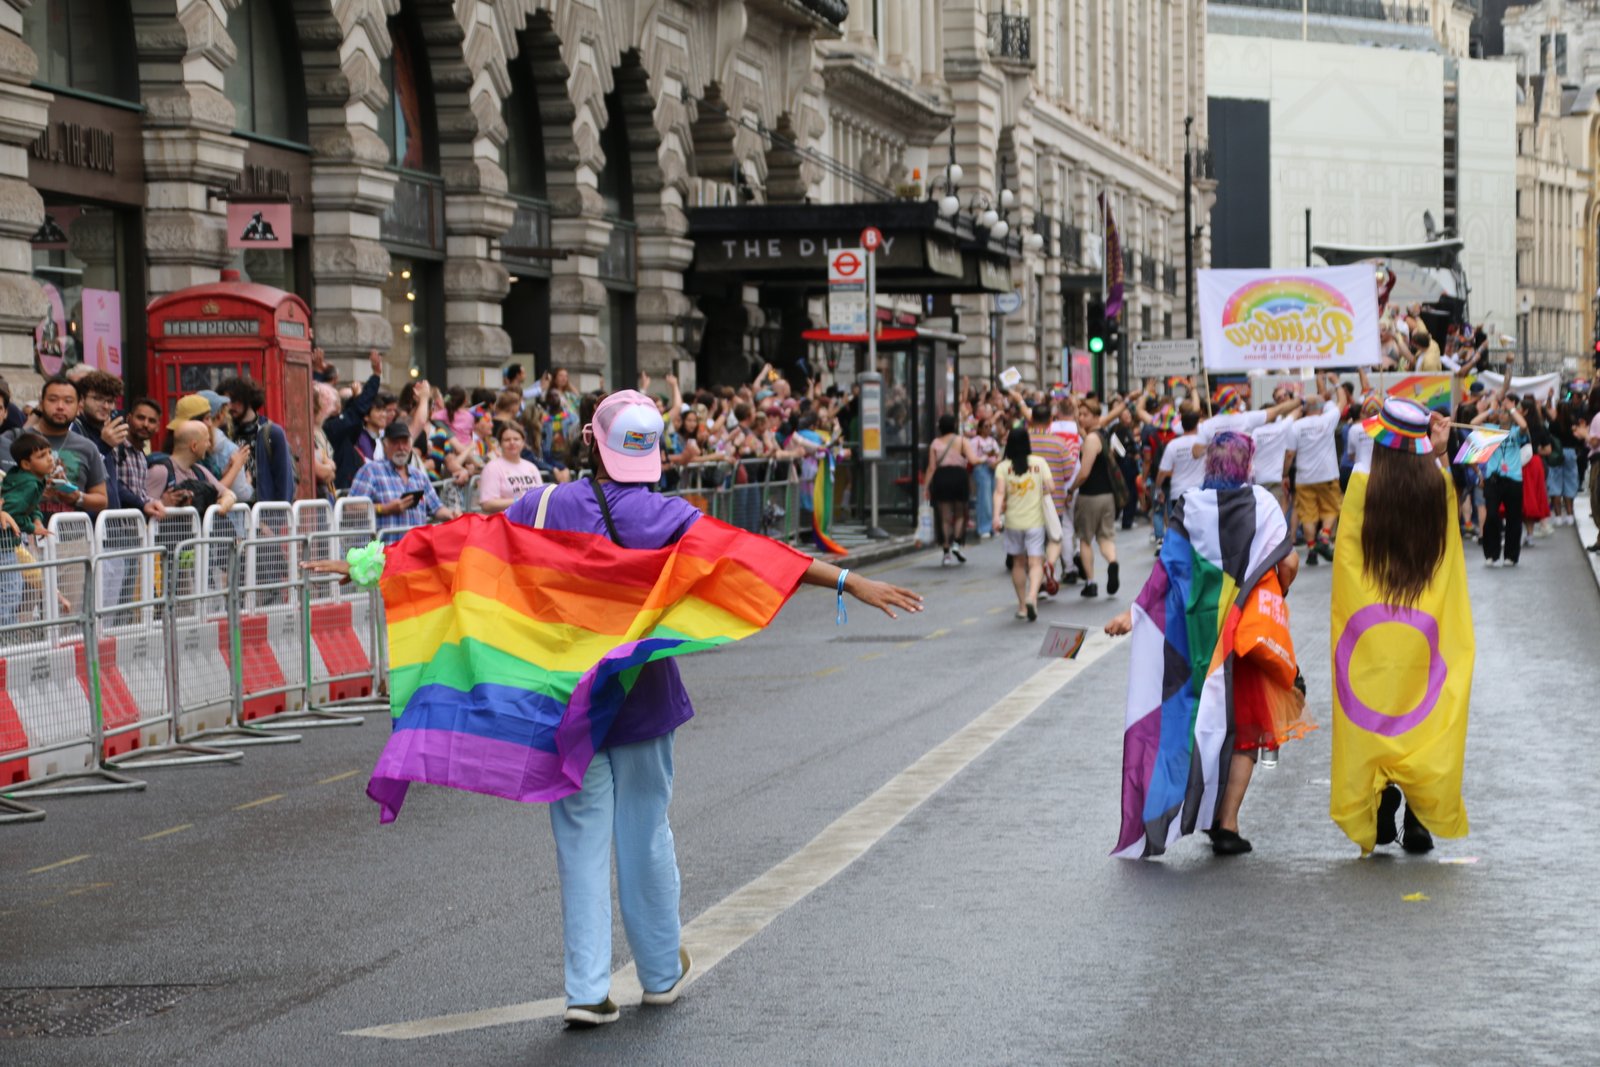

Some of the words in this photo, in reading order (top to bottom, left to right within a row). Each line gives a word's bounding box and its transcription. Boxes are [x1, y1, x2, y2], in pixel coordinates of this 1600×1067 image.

[866, 230, 876, 245] B
[722, 238, 782, 259] THE
[799, 237, 894, 257] DIY
[168, 320, 257, 334] TELEPHONE
